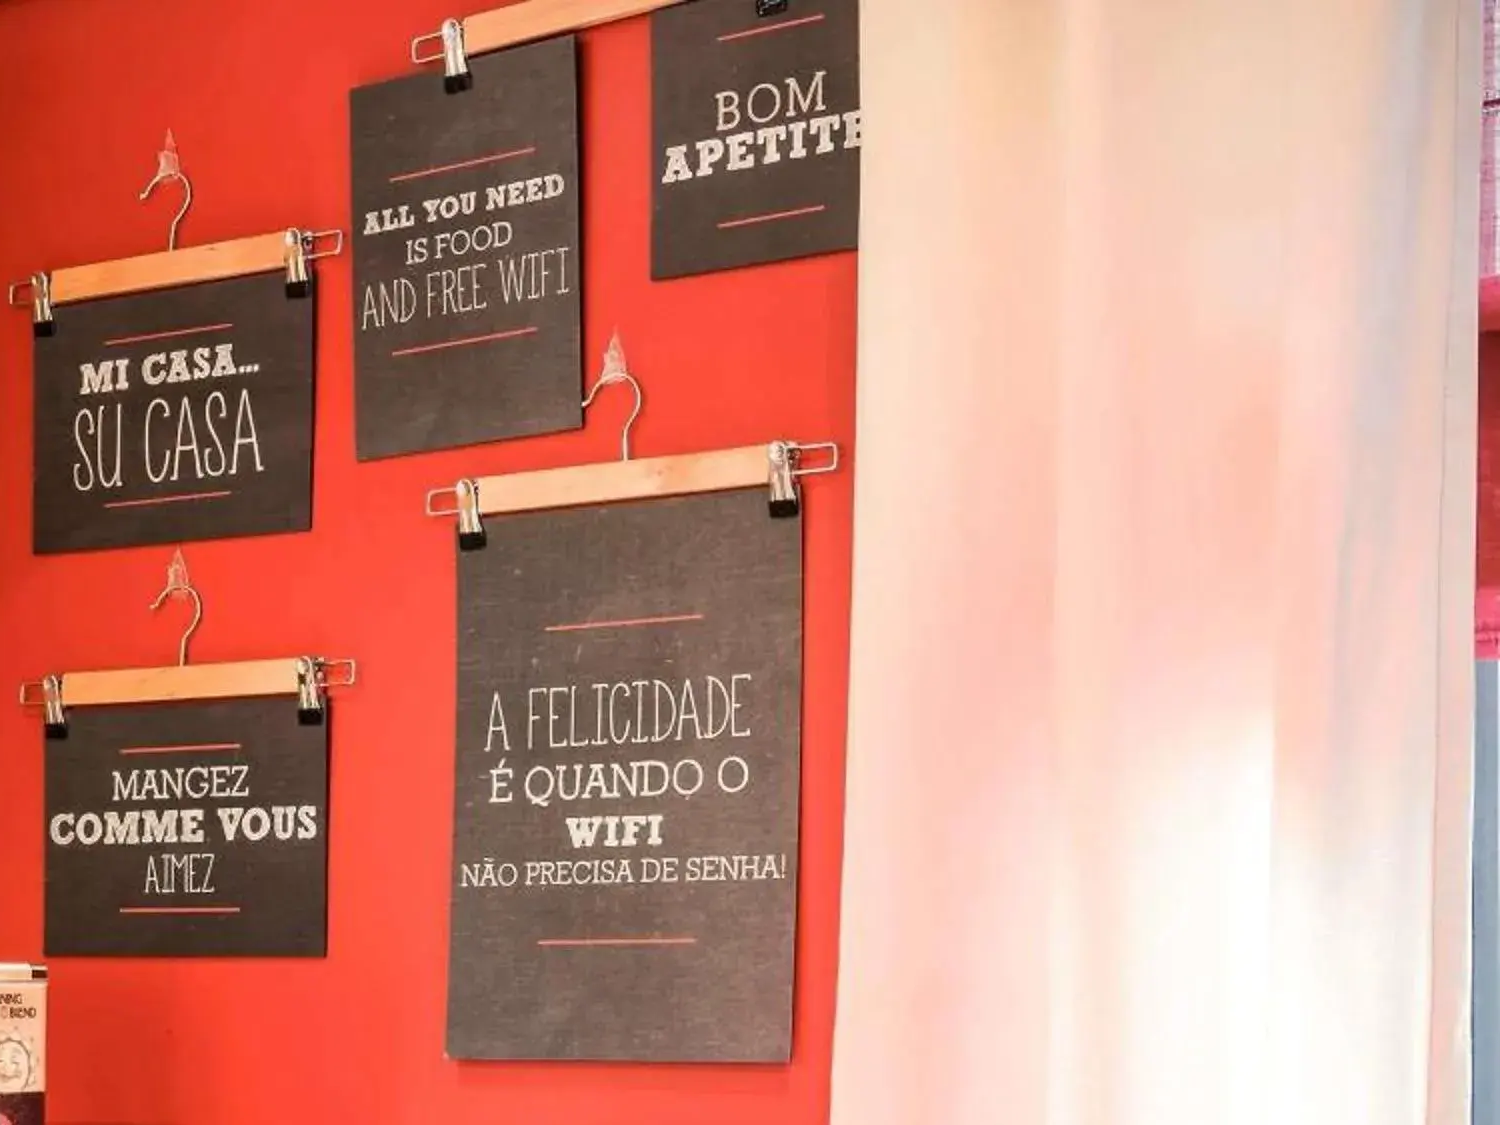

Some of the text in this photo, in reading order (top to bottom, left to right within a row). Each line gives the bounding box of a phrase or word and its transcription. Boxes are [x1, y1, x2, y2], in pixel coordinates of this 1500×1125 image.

[715, 71, 827, 131] BOM
[363, 173, 565, 236] ALL YOU NEED
[405, 221, 513, 265] IS FOOD
[361, 246, 570, 331] AND FREE WIFI
[79, 343, 261, 395] MI CASA...
[73, 388, 265, 491] SU CASA
[484, 674, 752, 751] A FELICIDADE
[111, 765, 250, 801] MANGEZ
[489, 755, 750, 807] É QUANDO O
[49, 805, 318, 845] COMME VOUS
[565, 815, 664, 848] WIFI
[144, 853, 216, 894] AIMEZ
[461, 854, 787, 888] NÃO PRECISA DE SENHA!
[9, 1007, 37, 1019] BLEND
